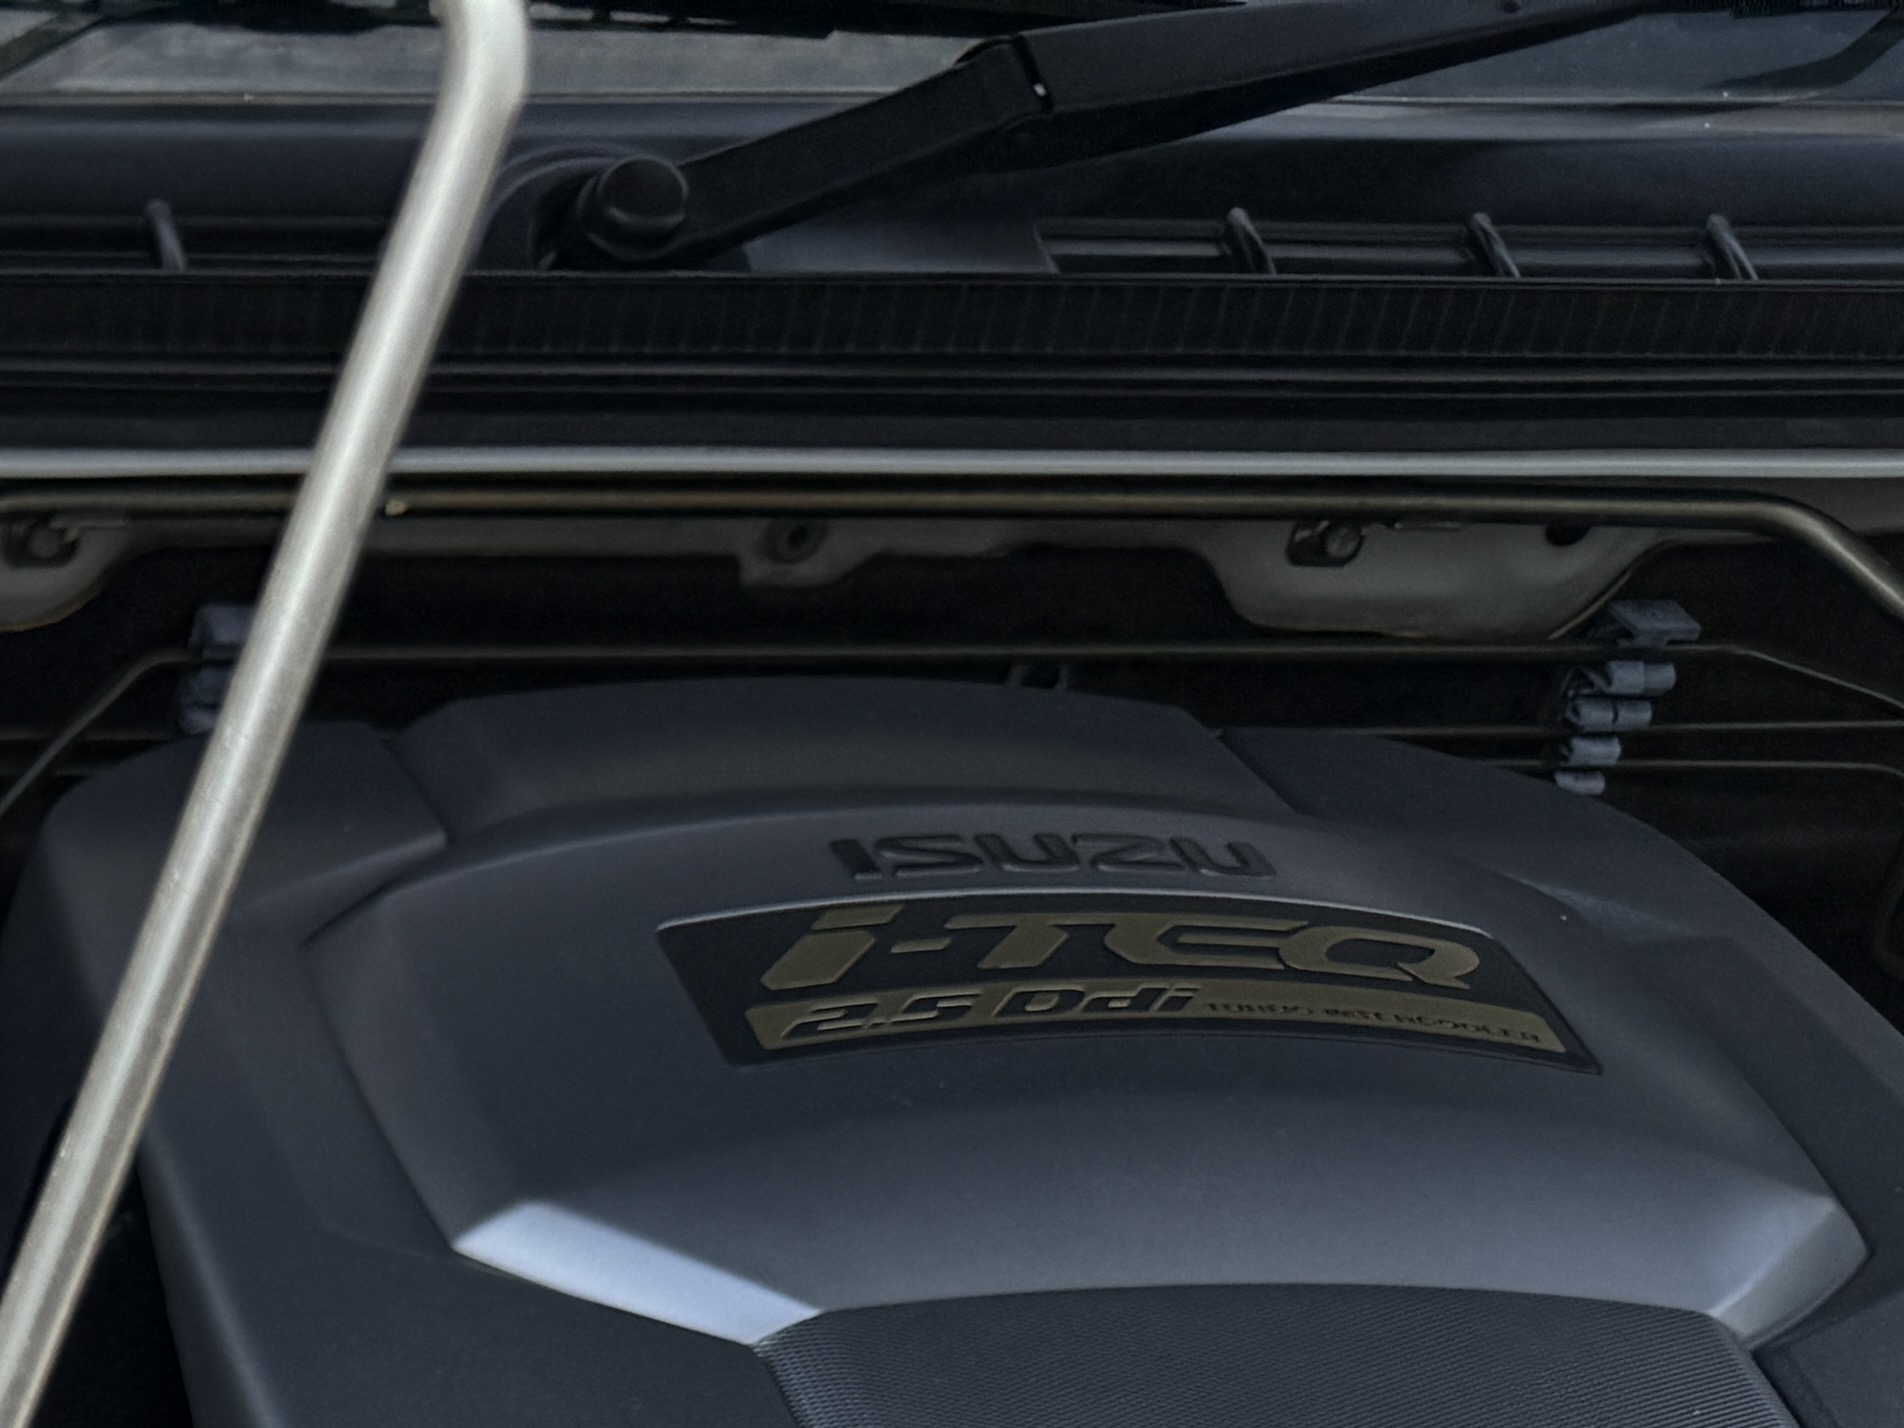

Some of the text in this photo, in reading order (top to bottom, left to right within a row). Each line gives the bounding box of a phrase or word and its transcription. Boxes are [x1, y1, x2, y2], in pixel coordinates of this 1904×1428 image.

[830, 832, 1276, 881] ISUZU
[759, 902, 1481, 991] i-TEQ
[780, 982, 1203, 1042] 2.5 Ddi
